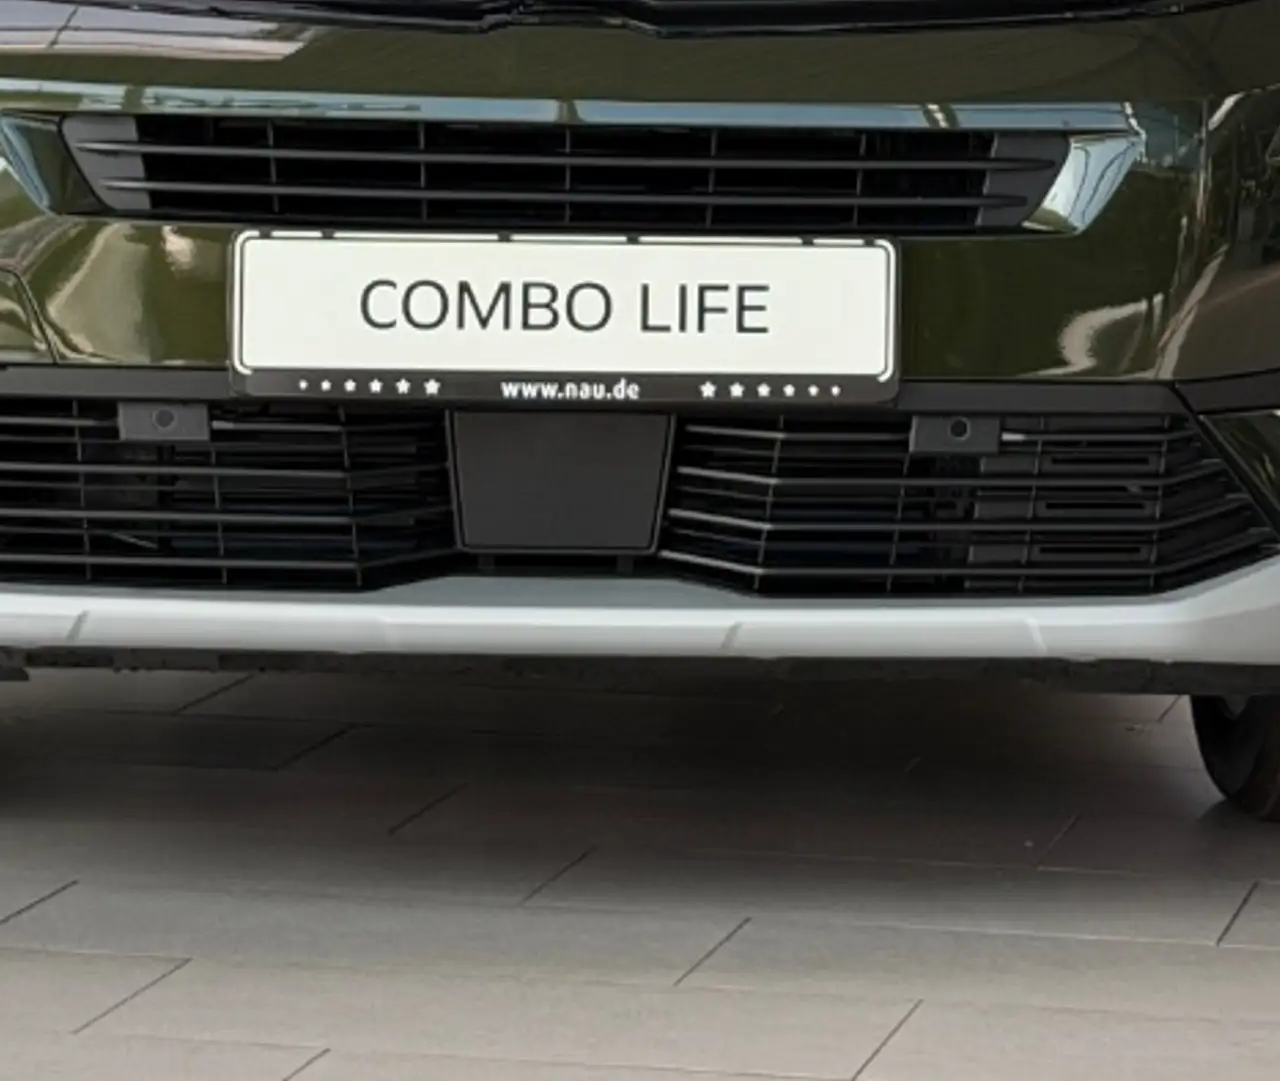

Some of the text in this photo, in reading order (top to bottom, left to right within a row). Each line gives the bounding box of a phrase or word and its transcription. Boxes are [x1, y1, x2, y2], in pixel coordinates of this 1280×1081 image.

[360, 279, 770, 333] COMBO LIFE
[500, 377, 640, 400] www.nau.de
